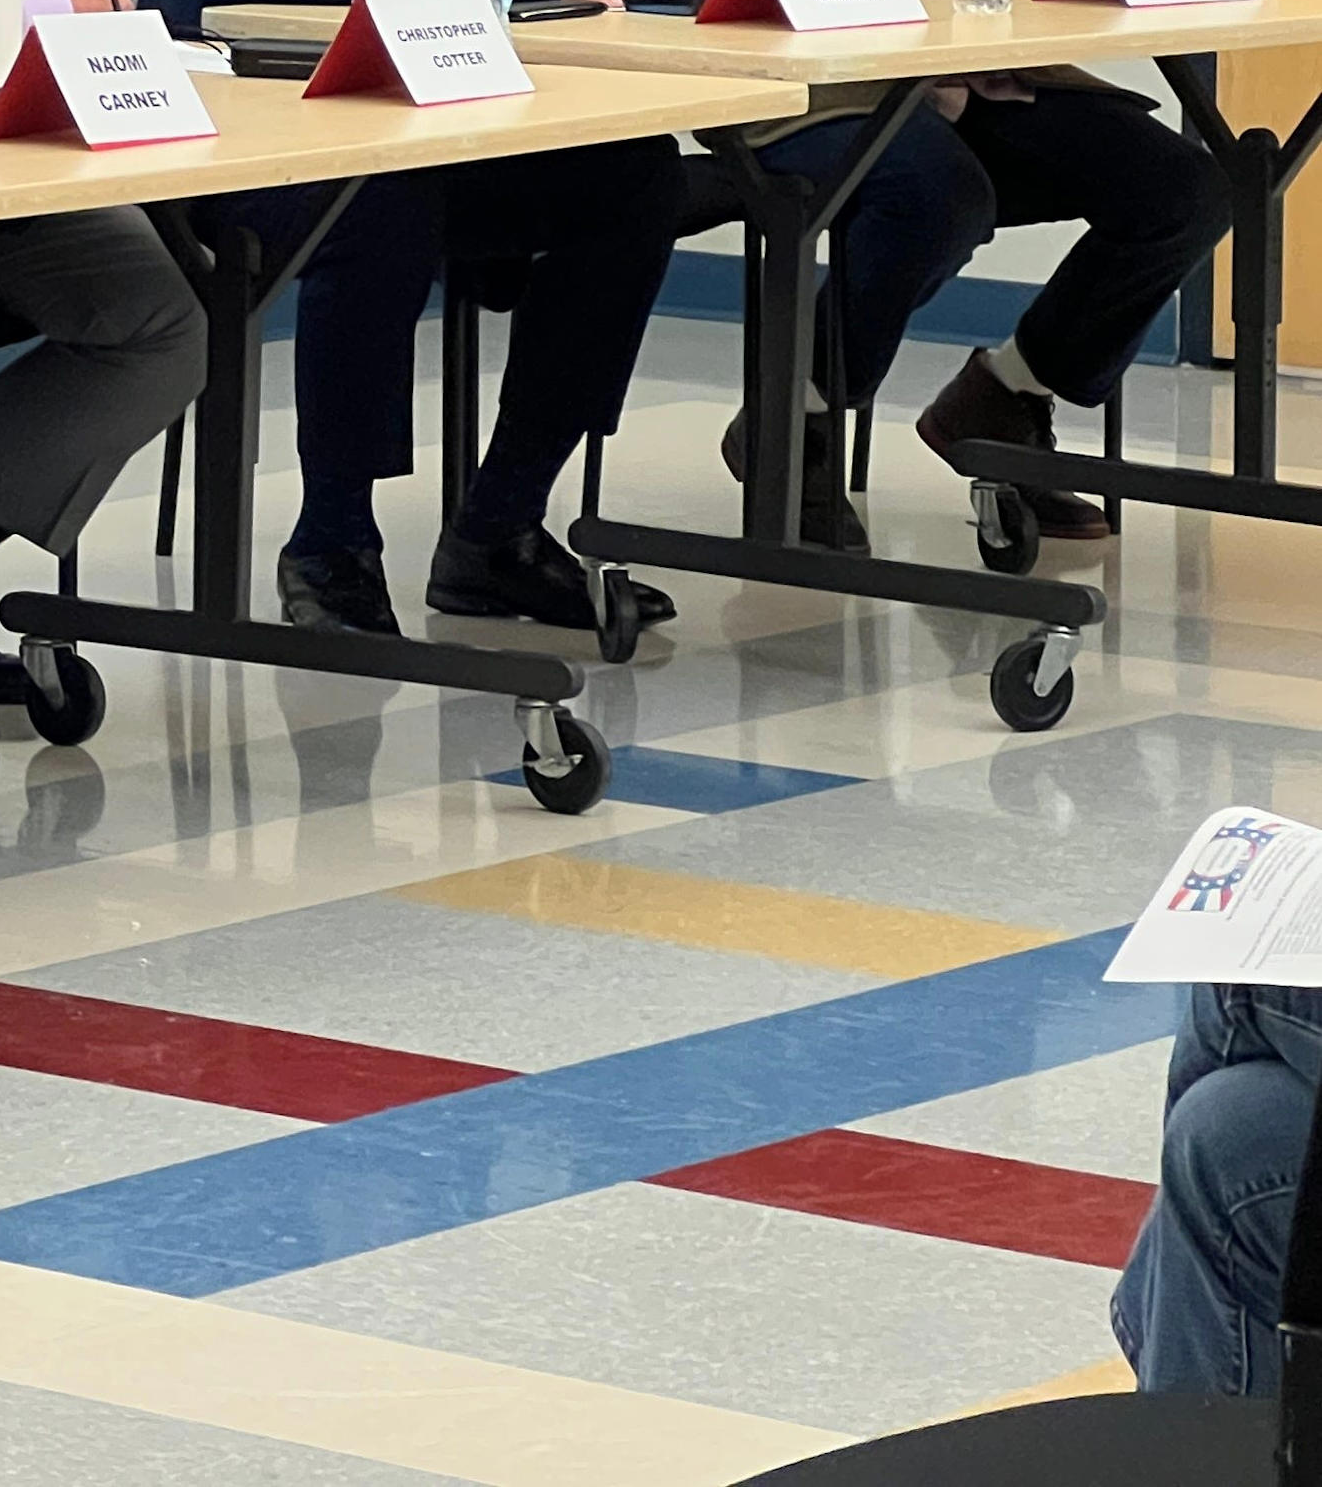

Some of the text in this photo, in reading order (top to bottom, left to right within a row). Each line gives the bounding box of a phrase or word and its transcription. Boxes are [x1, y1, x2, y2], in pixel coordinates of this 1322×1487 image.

[396, 22, 487, 44] CHRISTOPHER
[87, 54, 147, 76] NAOMI
[432, 50, 487, 69] COTTER
[98, 88, 171, 113] CARNEY
